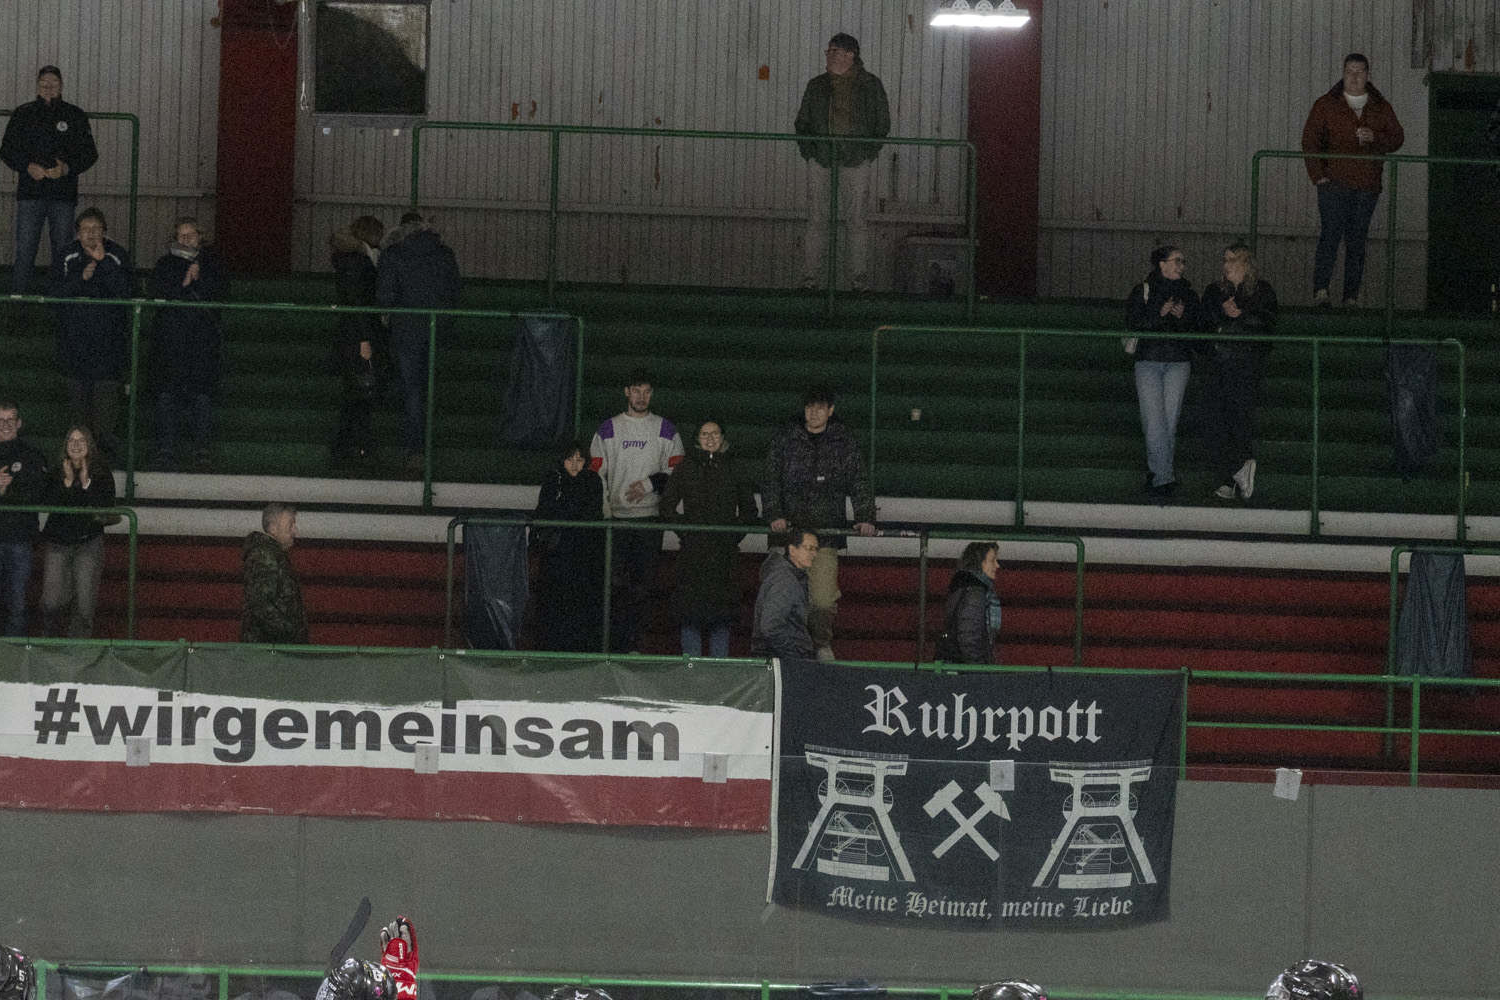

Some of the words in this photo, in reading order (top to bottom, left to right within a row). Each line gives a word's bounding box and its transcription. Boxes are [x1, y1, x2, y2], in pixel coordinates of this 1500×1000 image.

[33, 688, 680, 762] #wirgemeinsam
[862, 684, 1103, 751] Ruhrpott
[826, 886, 898, 913] Meine
[906, 891, 993, 920] Heimat,
[1002, 896, 1065, 918] meine
[1073, 897, 1133, 918] Liebe
[18, 969, 25, 982] 5
